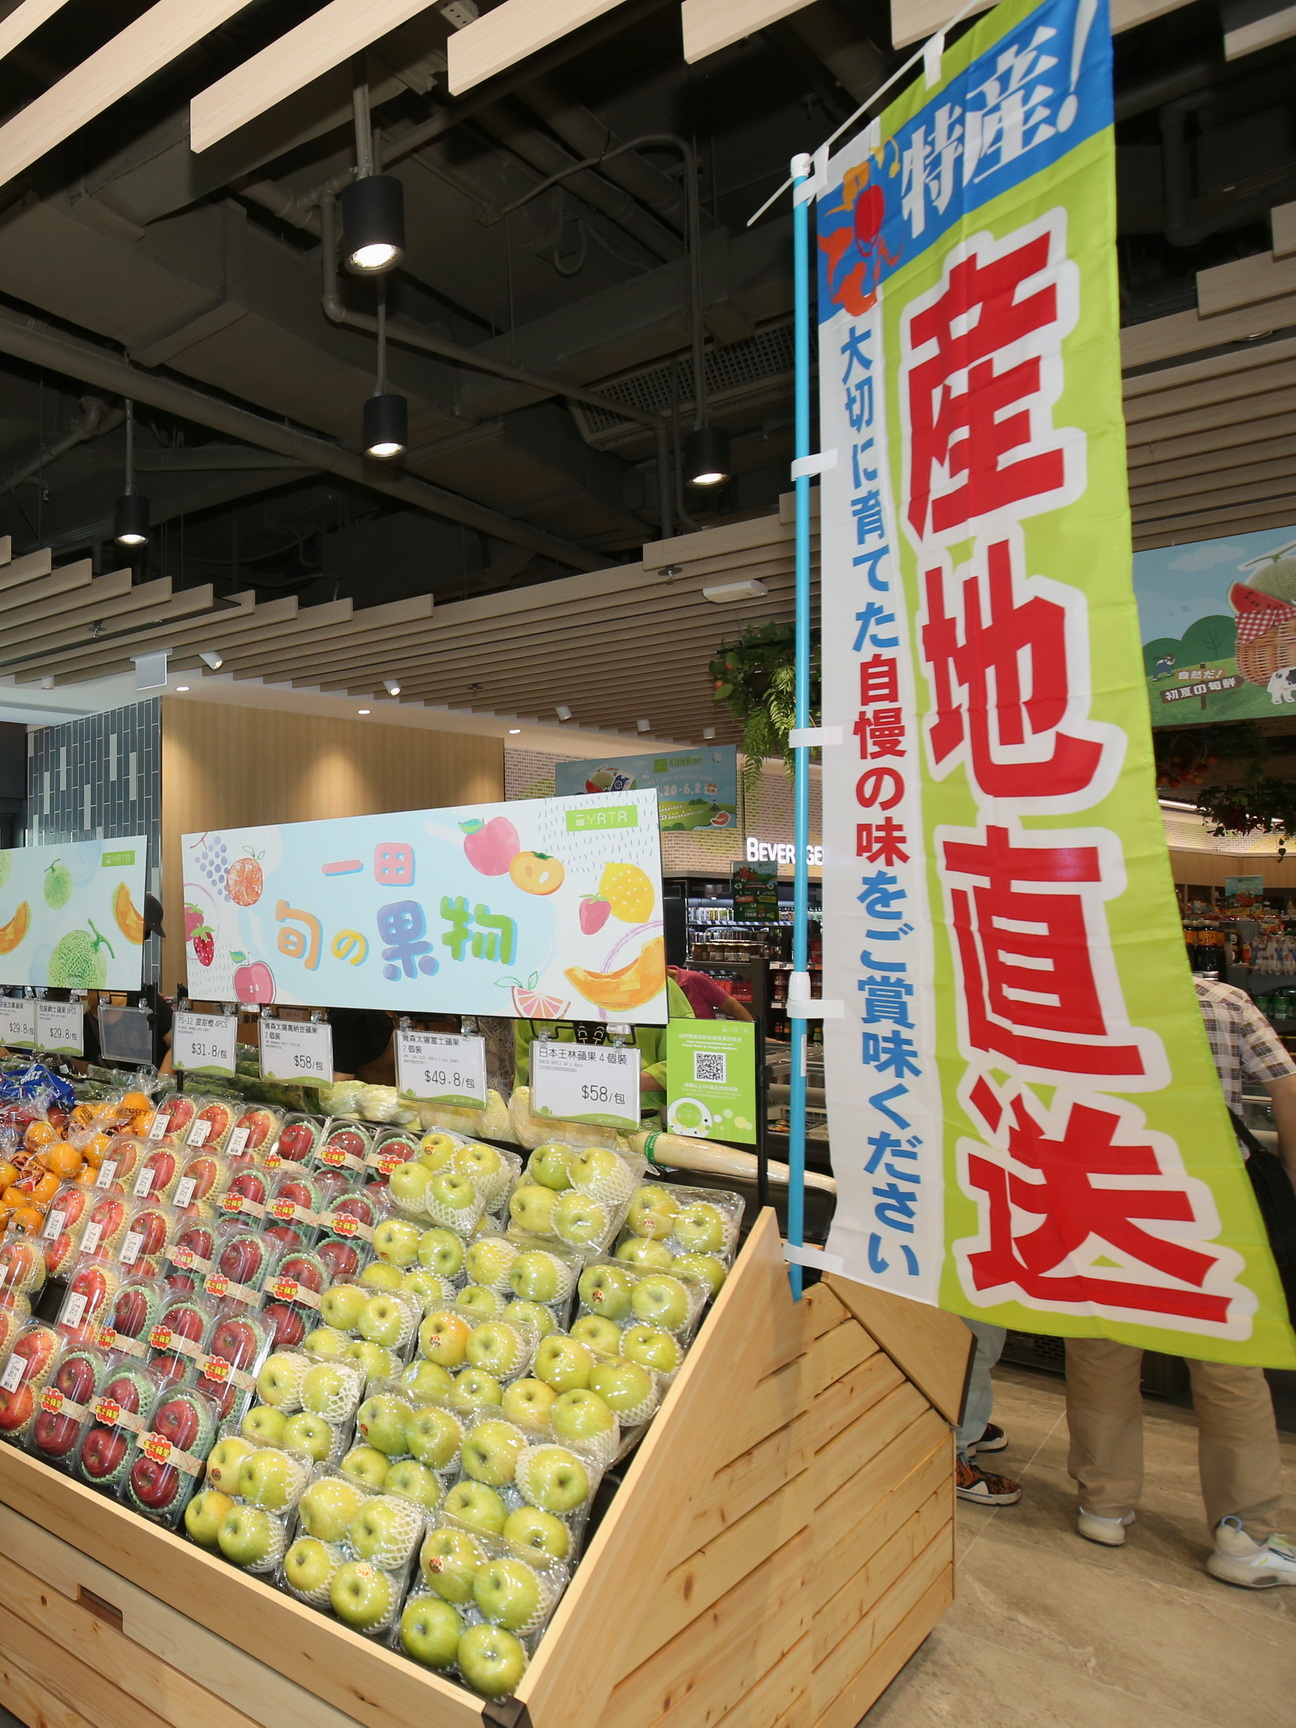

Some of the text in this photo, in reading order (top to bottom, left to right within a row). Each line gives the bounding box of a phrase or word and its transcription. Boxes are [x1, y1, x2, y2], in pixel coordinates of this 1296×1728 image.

[1165, 677, 1237, 701] 初夏の旬鮮
[840, 325, 923, 1277] 大切に育てた自慢の味をご賞味ください
[908, 232, 1232, 1324] 産地直送
[321, 842, 415, 887] 一田
[746, 837, 823, 866] BEVERGE
[275, 895, 517, 982] 旬の果物
